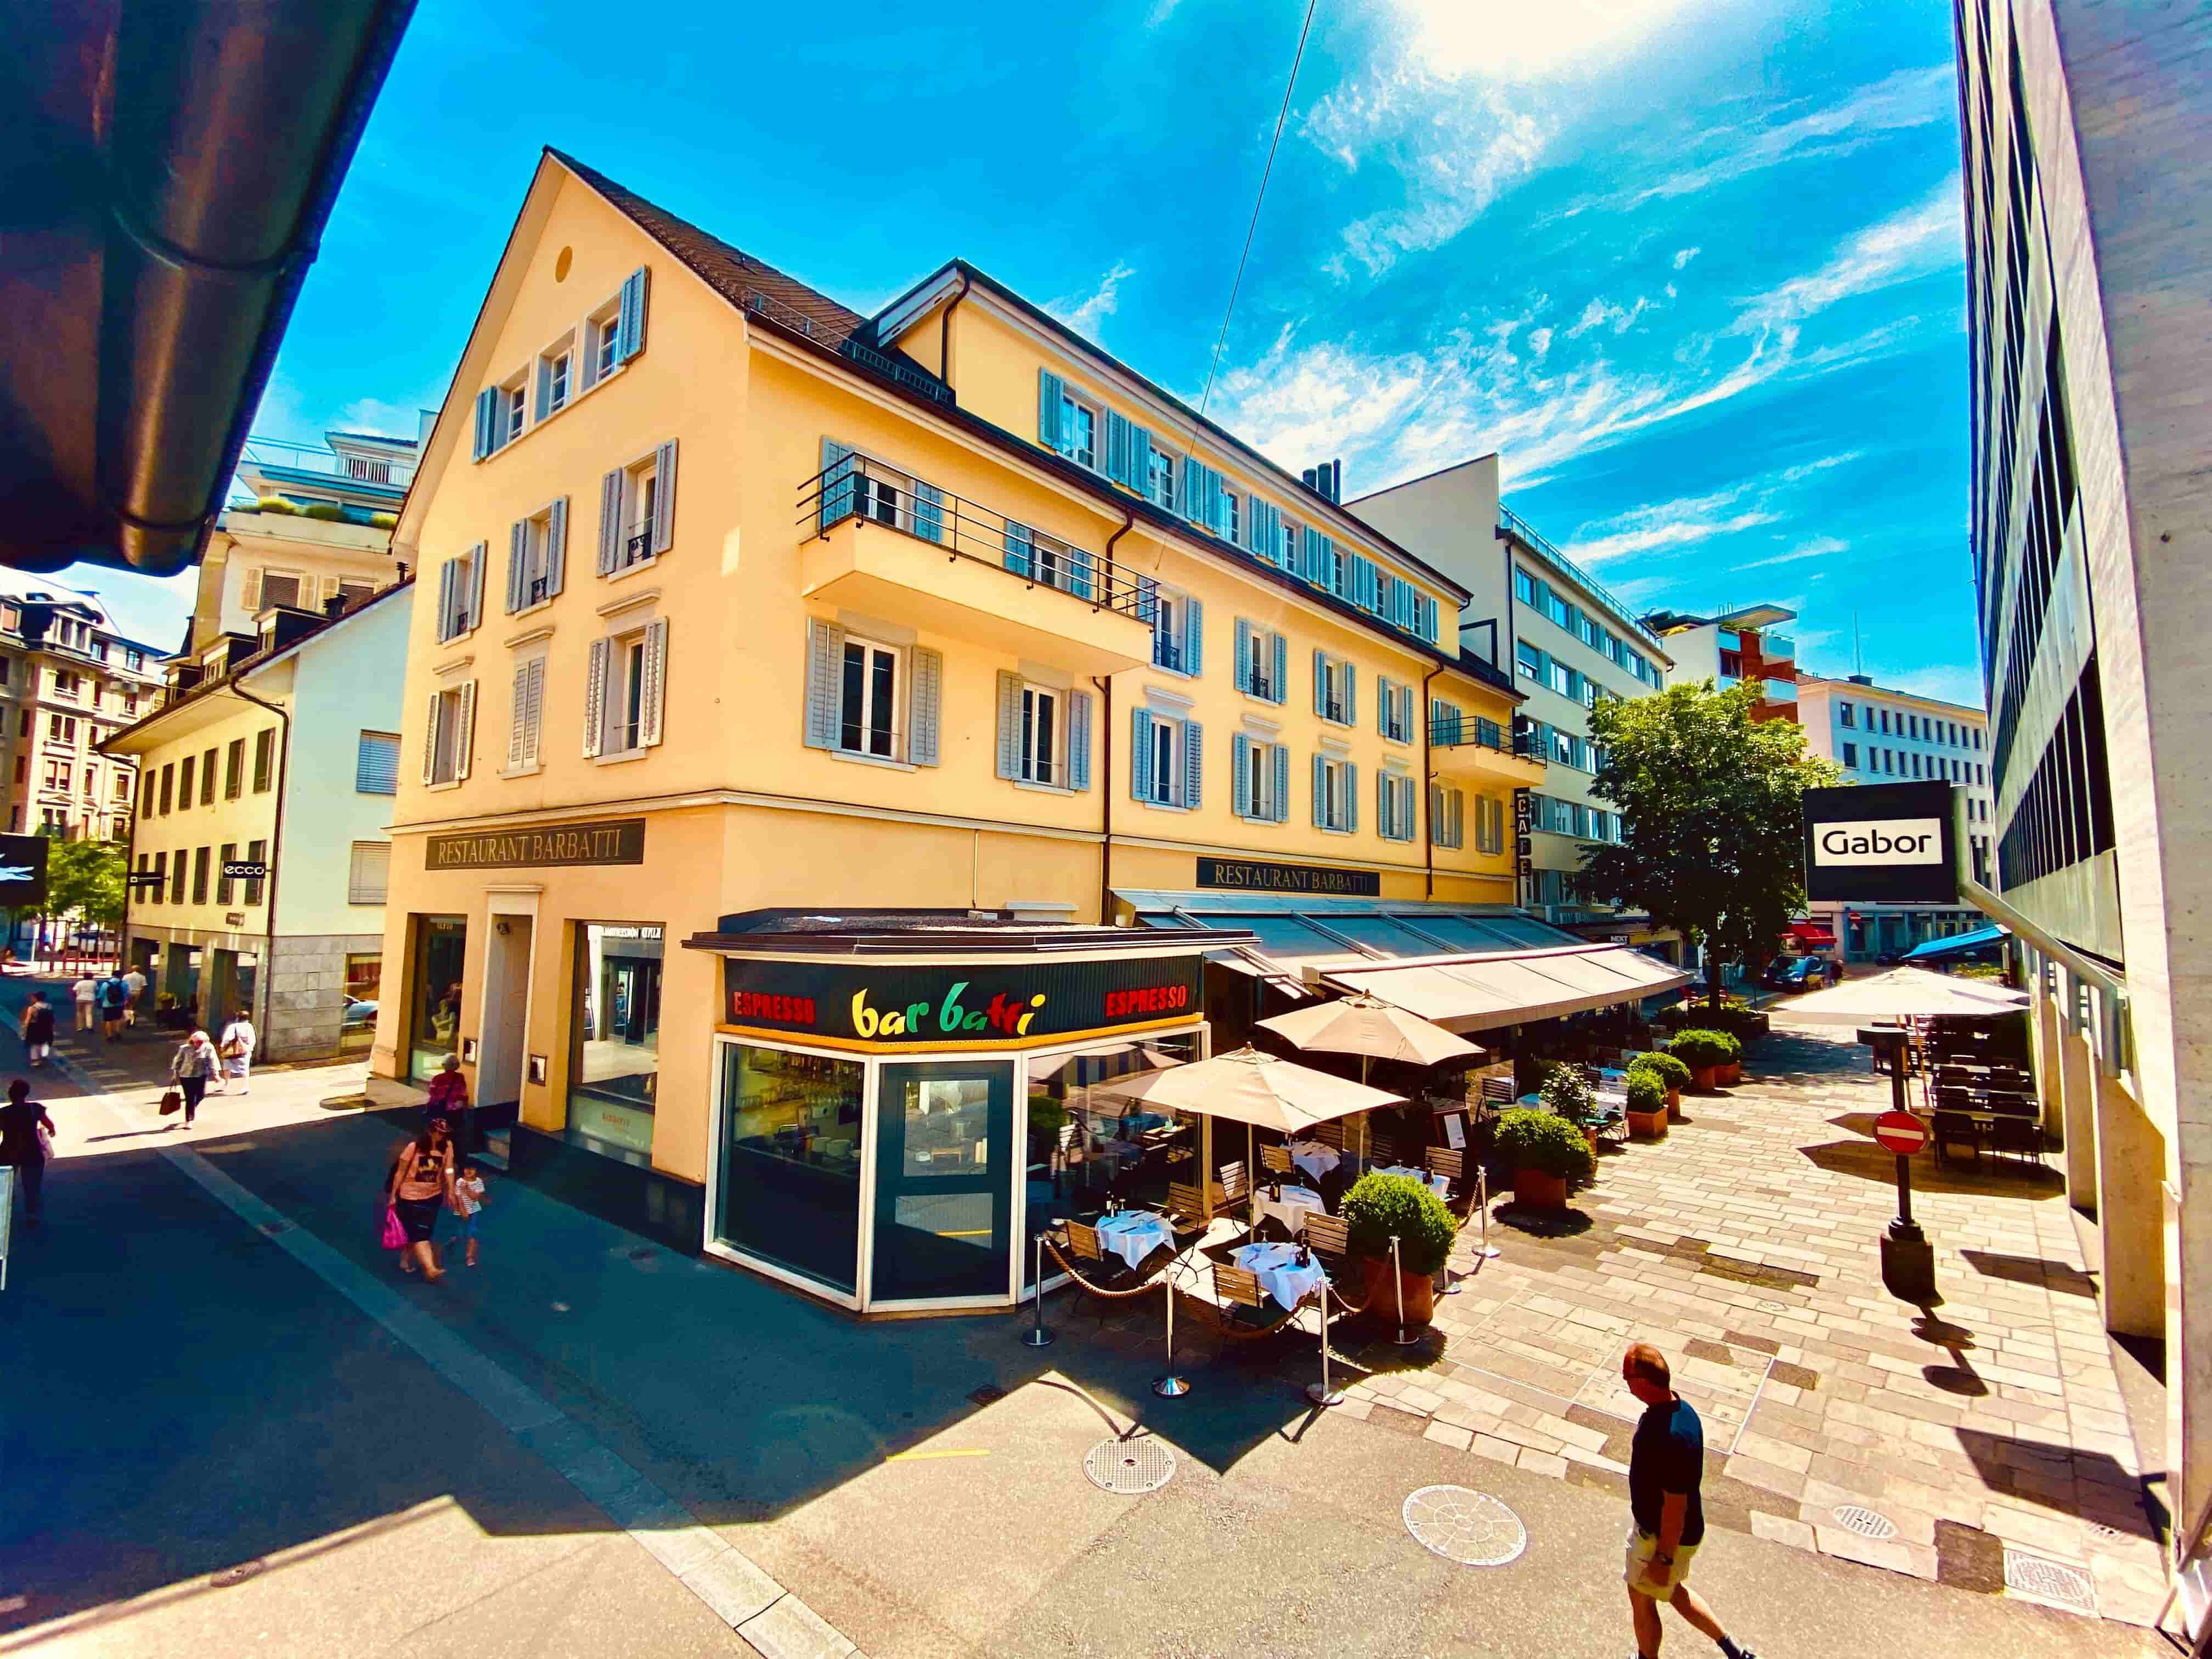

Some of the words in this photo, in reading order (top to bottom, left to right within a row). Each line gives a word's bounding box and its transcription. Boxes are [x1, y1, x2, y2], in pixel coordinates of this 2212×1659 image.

[438, 835, 528, 865] RESTAURANT
[532, 829, 622, 860] BARBATTI
[1822, 829, 1932, 855] Gabor
[224, 865, 264, 875] ecco
[1215, 864, 1308, 888] RESTAURANT
[1312, 872, 1370, 892] BARBATTI
[1610, 935, 1628, 944] NEXT
[733, 991, 816, 1025] ESPRESSO
[851, 988, 929, 1038] bar
[939, 981, 1046, 1036] batti
[1105, 985, 1188, 1018] ESPRESSO
